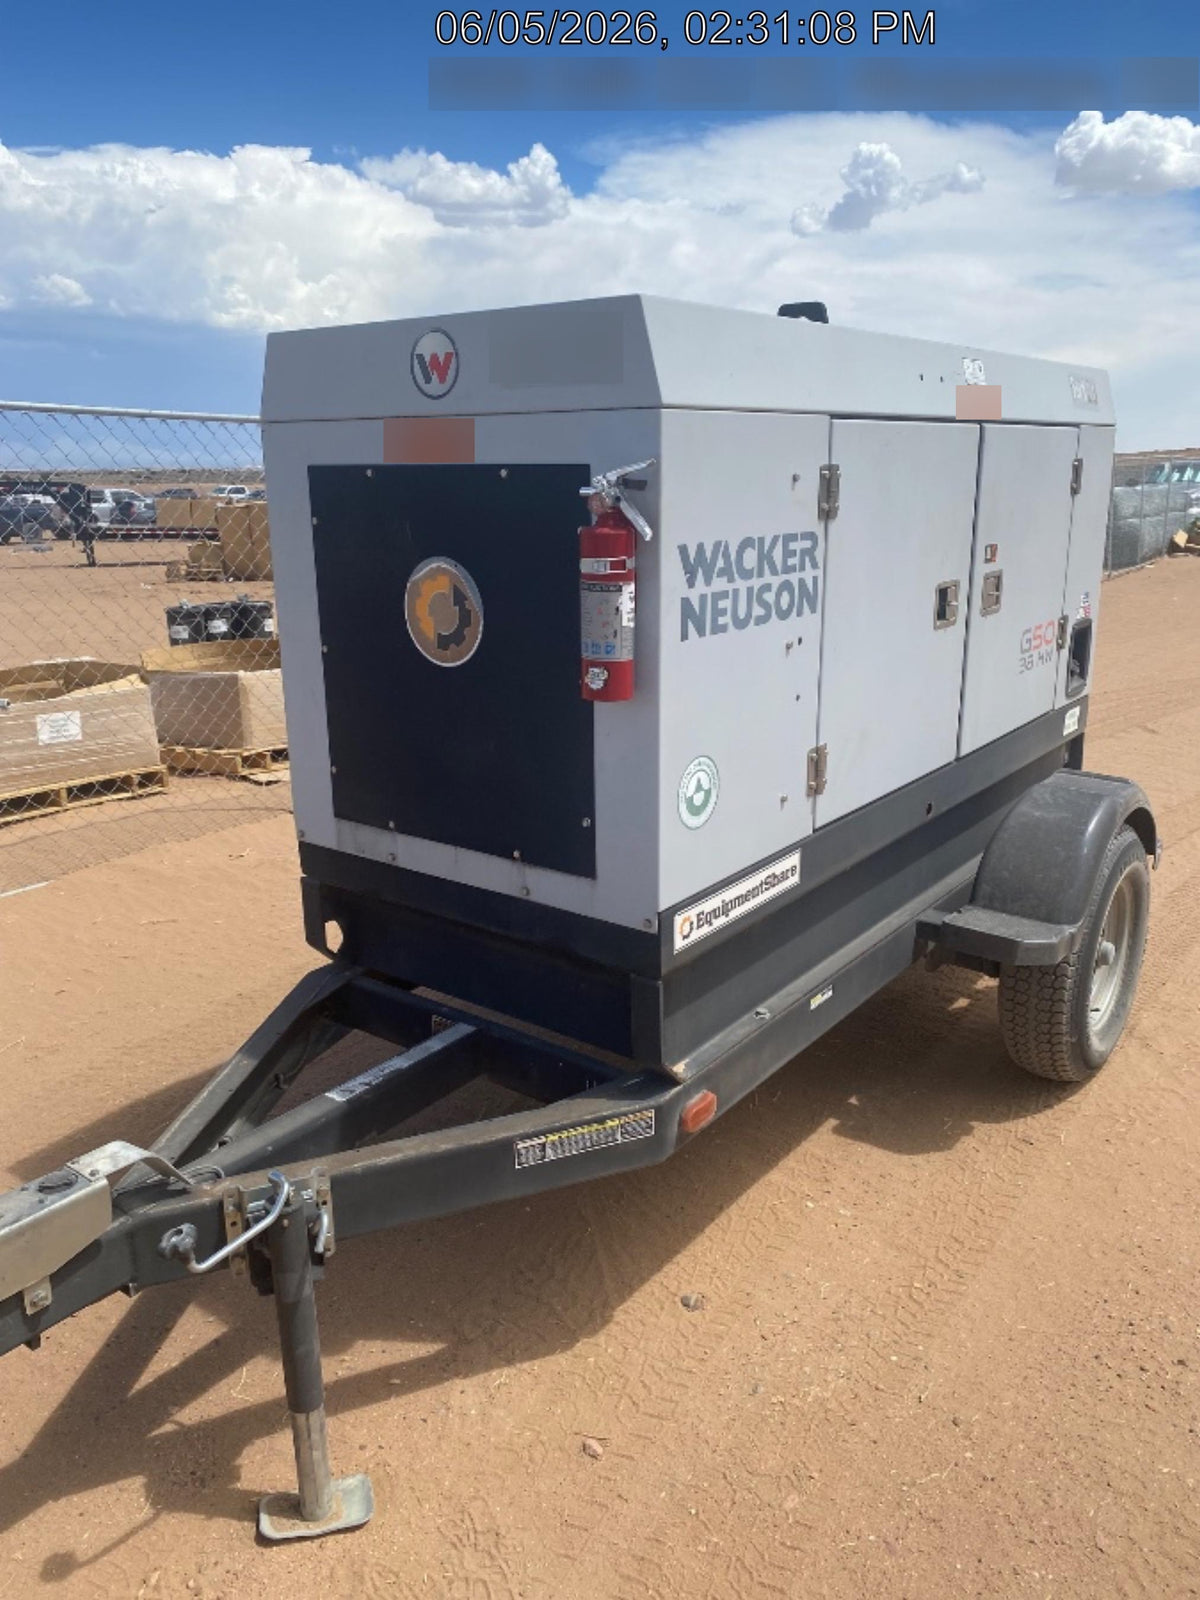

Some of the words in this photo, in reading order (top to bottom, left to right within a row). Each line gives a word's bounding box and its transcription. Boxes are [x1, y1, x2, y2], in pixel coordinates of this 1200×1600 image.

[677, 531, 820, 589] WACKER
[680, 575, 818, 642] NEUSON
[1020, 619, 1055, 655] G50
[695, 864, 798, 930] EquipmentShare
